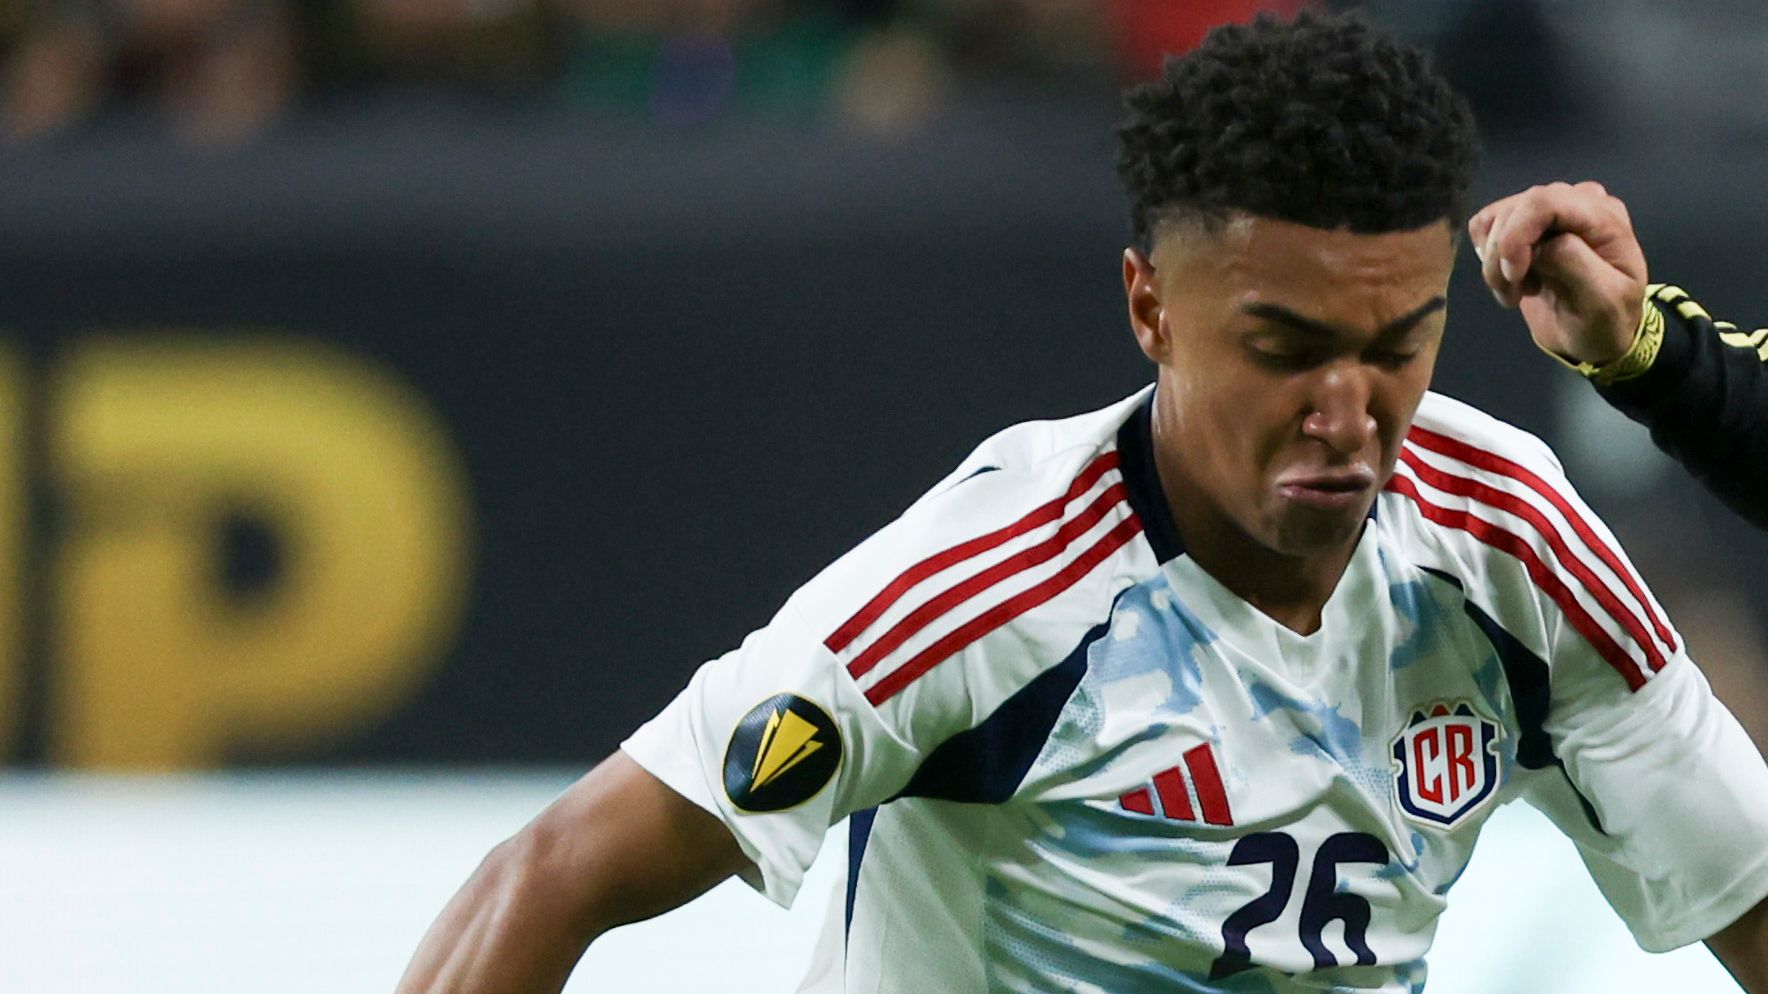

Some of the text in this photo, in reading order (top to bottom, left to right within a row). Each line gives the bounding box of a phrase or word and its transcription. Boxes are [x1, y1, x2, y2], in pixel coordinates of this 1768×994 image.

[0, 335, 475, 770] P
[1413, 724, 1476, 806] CR
[1208, 831, 1390, 982] 26
